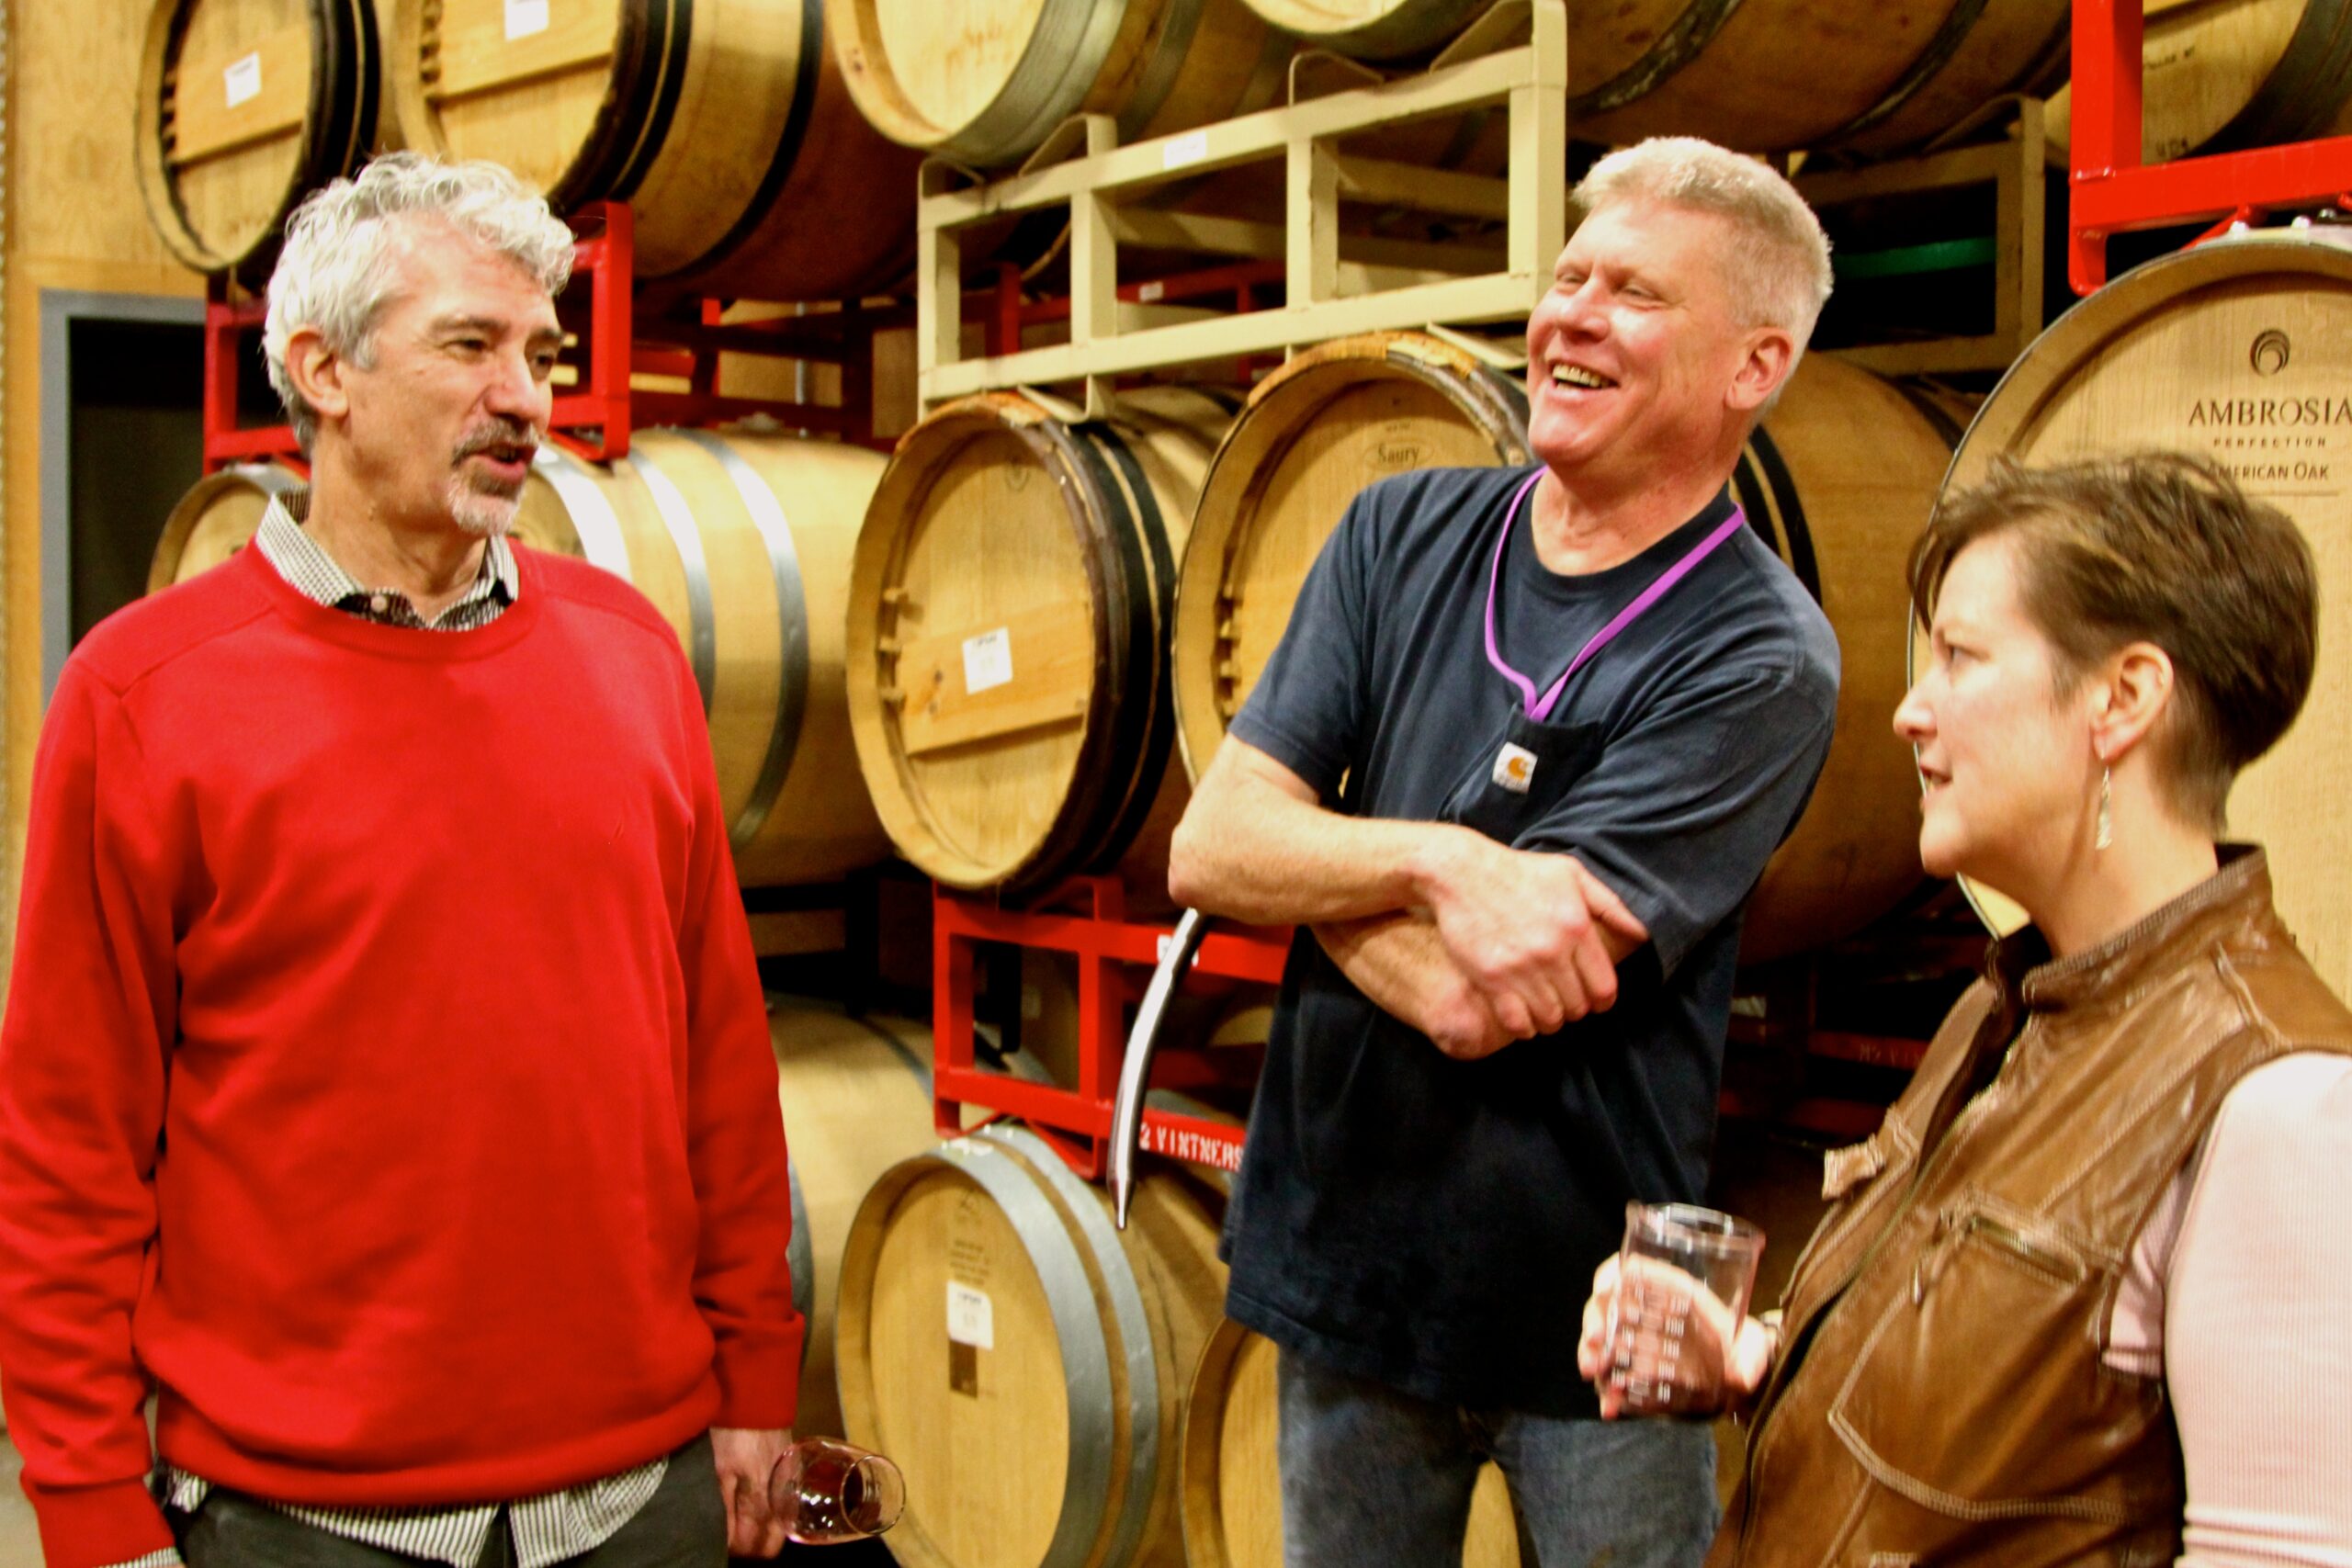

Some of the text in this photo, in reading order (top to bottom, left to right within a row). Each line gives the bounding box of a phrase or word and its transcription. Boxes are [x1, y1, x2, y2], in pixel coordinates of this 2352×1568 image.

[2188, 397, 2352, 427] AMBROSIA
[1378, 442, 1420, 471] Saury
[2213, 435, 2326, 449] PERFECTION
[1156, 1124, 1244, 1174] VINTNERS
